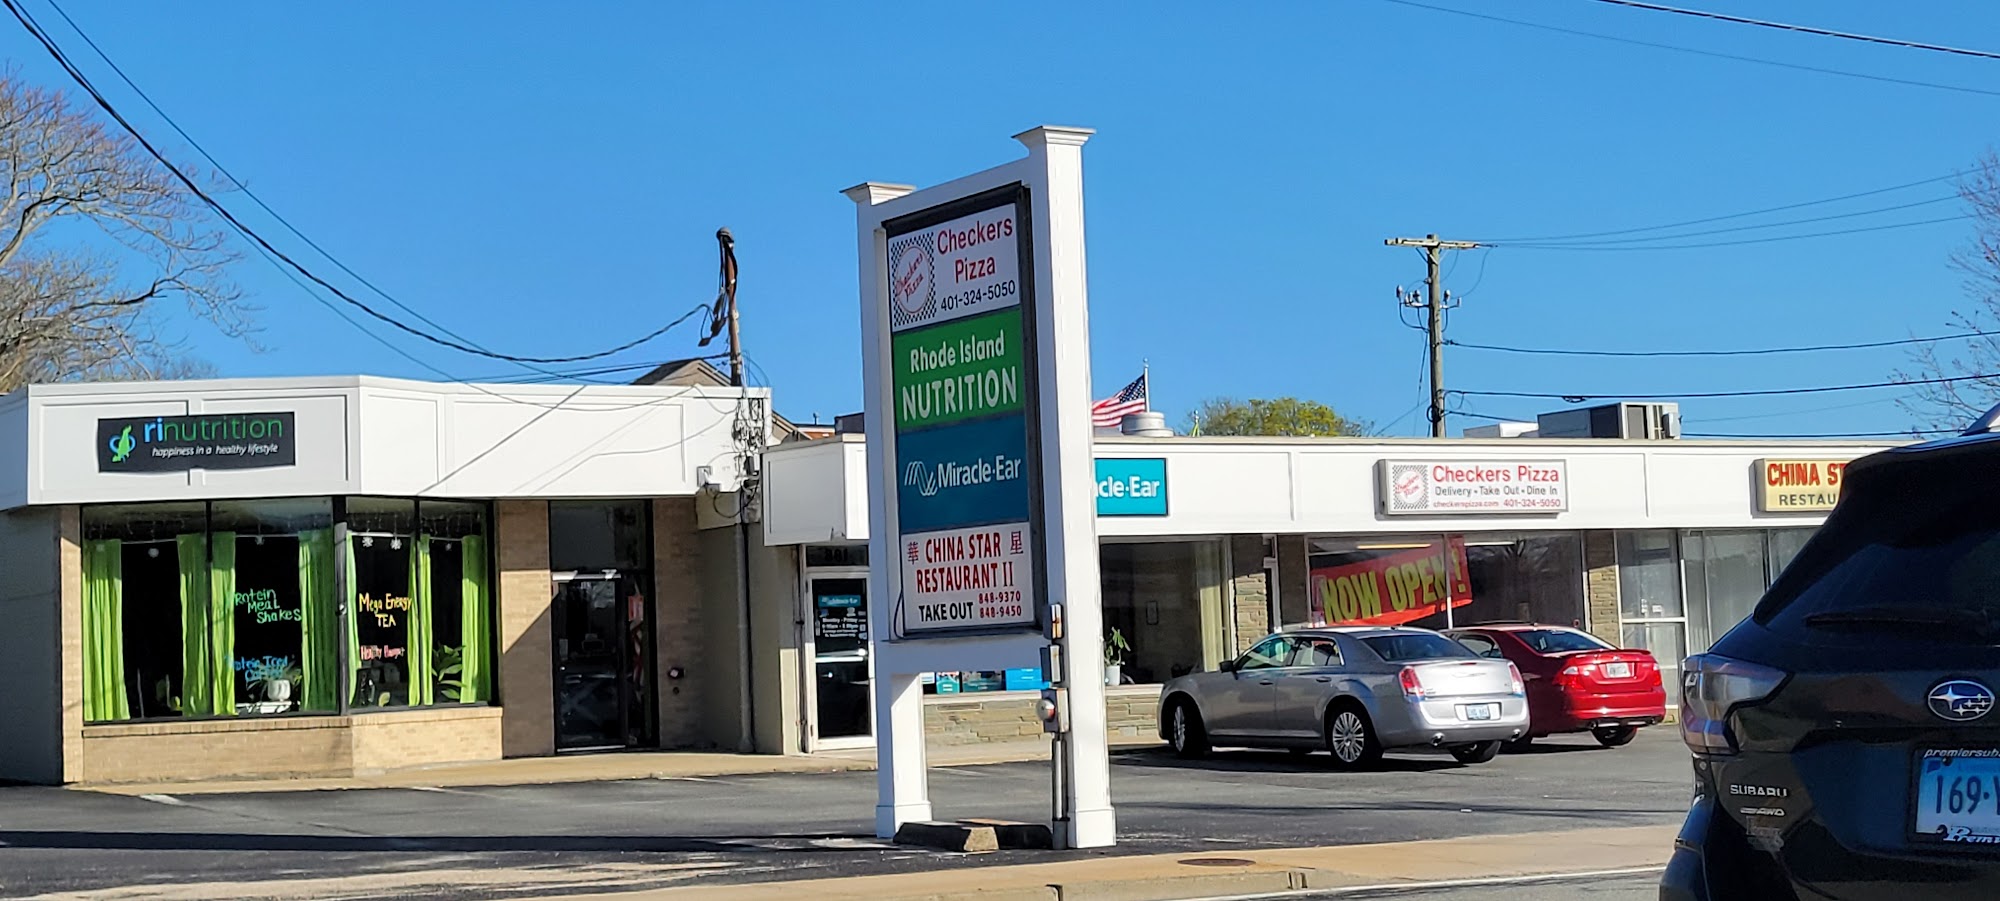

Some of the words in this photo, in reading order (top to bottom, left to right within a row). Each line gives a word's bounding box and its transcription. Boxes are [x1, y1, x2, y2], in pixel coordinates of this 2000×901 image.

[937, 218, 1013, 255] Checkers
[955, 256, 995, 284] Pizza
[941, 279, 1016, 311] 401-324-5050
[910, 341, 956, 373] Rhode
[959, 329, 1005, 363] Island
[902, 366, 1017, 422] NUTRITION
[144, 416, 283, 442] rinutrition
[152, 446, 194, 458] happiness
[195, 445, 204, 455] in
[215, 444, 246, 457] healthy
[248, 443, 278, 456] lifestyle
[1432, 465, 1511, 482] Checkers
[1517, 465, 1559, 482] Pizza
[1767, 463, 1820, 486] CHINA
[1827, 463, 1847, 485] ST
[1434, 486, 1471, 497] Delivery
[1479, 486, 1500, 496] Take
[1503, 485, 1519, 496] Out
[1526, 485, 1546, 496] Dine
[1549, 485, 1558, 495] In
[1779, 494, 1836, 506] RESTAU
[1433, 499, 1499, 509] checkerspizza.com
[1503, 499, 1561, 508] 401-324-5050
[925, 535, 965, 563] CHINA
[968, 532, 1001, 559] STAR
[1010, 530, 1024, 556] 星
[916, 562, 998, 594] RESTAURANT
[978, 590, 1021, 604] 848-9370
[375, 613, 396, 628] TEA
[918, 603, 947, 622] TAKE
[949, 601, 973, 620] OUT
[980, 605, 1022, 619] 848-9450
[1923, 748, 2000, 759] premiersub
[1730, 784, 1787, 797] SUBARU
